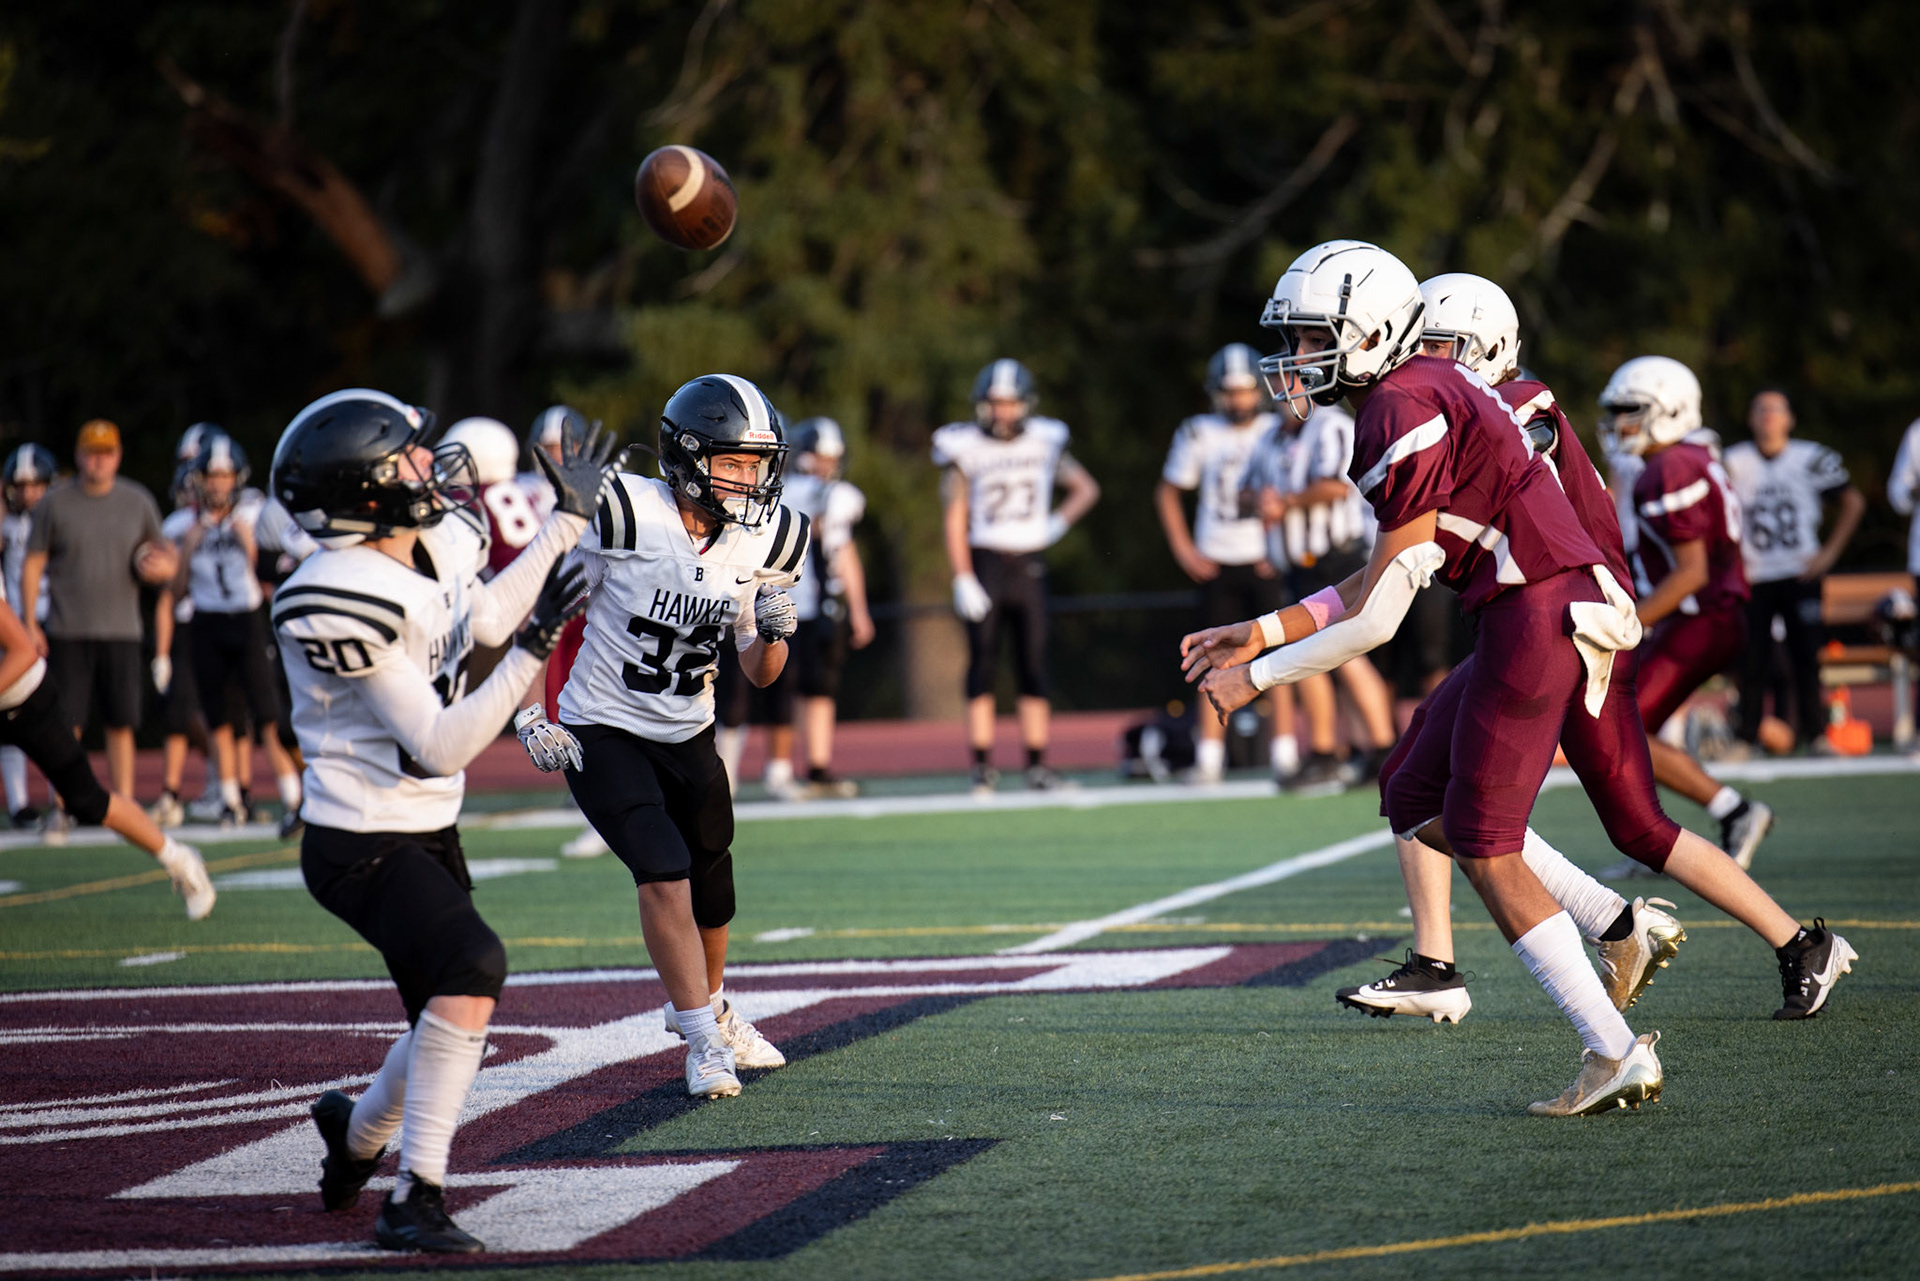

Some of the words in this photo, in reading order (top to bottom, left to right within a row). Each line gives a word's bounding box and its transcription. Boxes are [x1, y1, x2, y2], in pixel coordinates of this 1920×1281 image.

[694, 567, 704, 581] B
[648, 588, 730, 624] HAWKS
[297, 637, 373, 674] 20
[622, 616, 718, 697] 32
